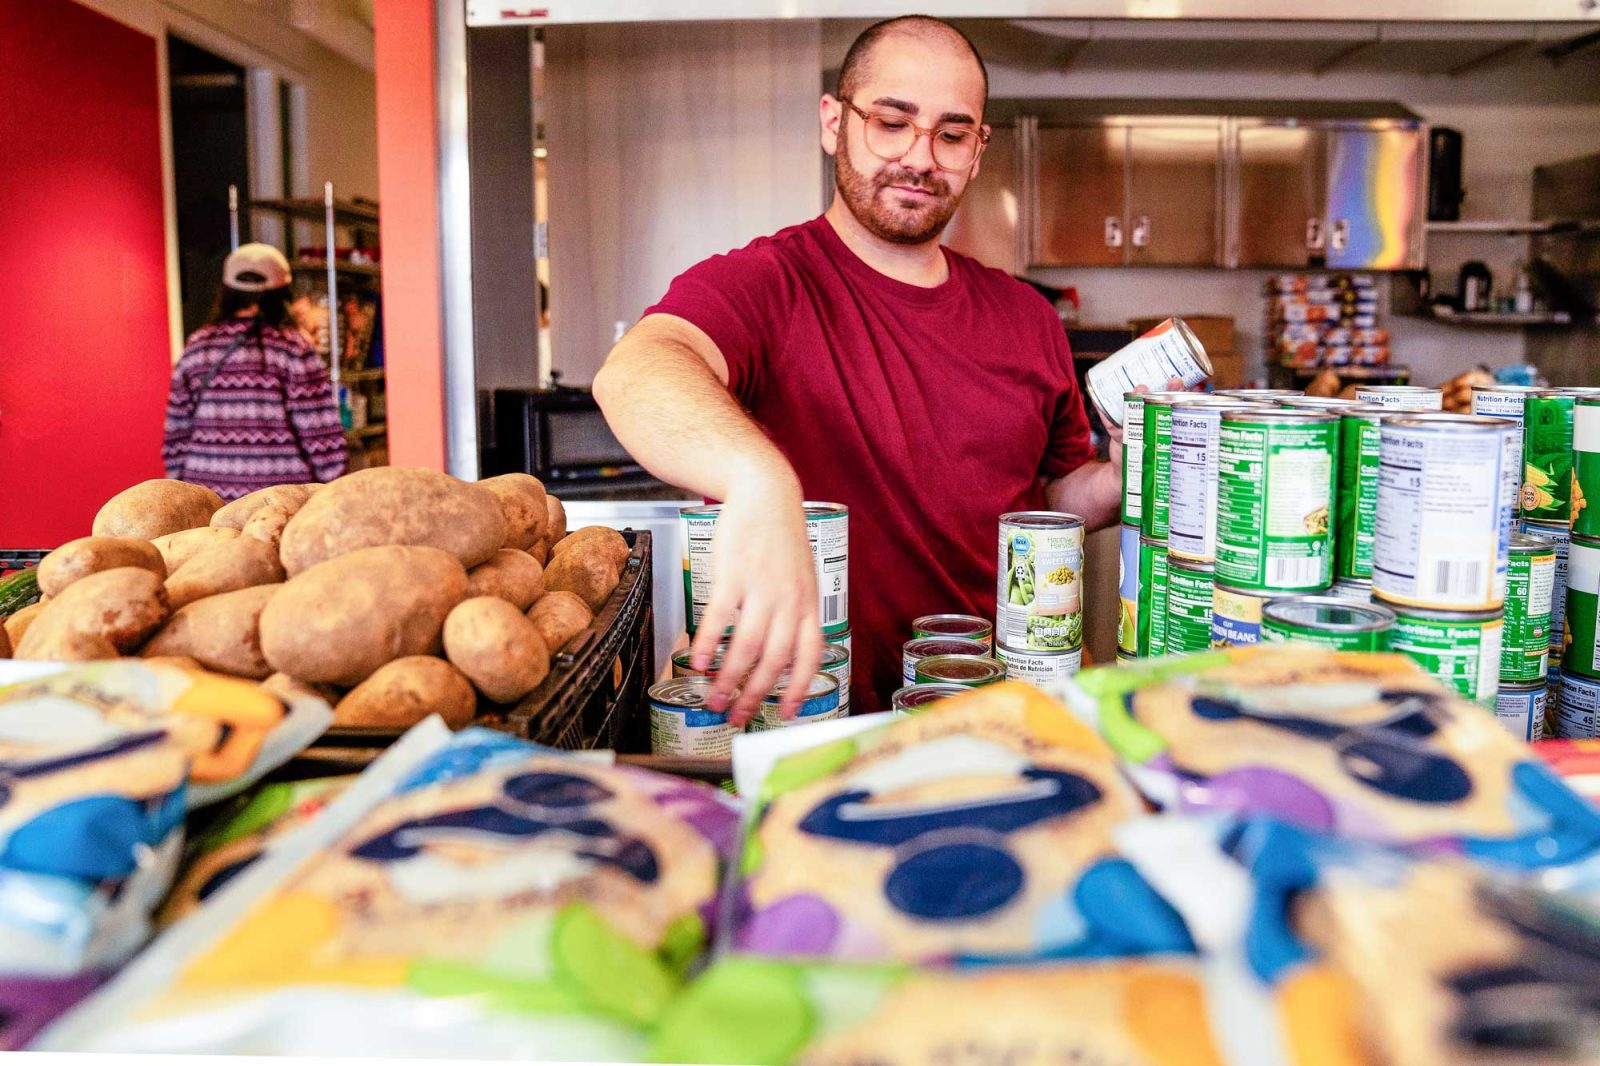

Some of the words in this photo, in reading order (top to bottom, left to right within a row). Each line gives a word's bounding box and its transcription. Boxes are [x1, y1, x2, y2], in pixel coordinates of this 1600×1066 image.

[1477, 395, 1503, 403] Nutrition
[1189, 420, 1207, 428] Facts
[1196, 453, 1206, 462] 15
[1409, 477, 1421, 488] 15
[688, 519, 711, 527] Nutrition
[1551, 536, 1570, 544] Facts
[1557, 563, 1568, 571] 45
[1195, 580, 1213, 588] Fact
[1516, 587, 1527, 595] 60
[1228, 629, 1257, 643] BEANS
[1447, 627, 1480, 638] Facts
[1006, 655, 1026, 664] Nutrition
[1578, 687, 1596, 697] Facts
[1583, 715, 1593, 724] 45
